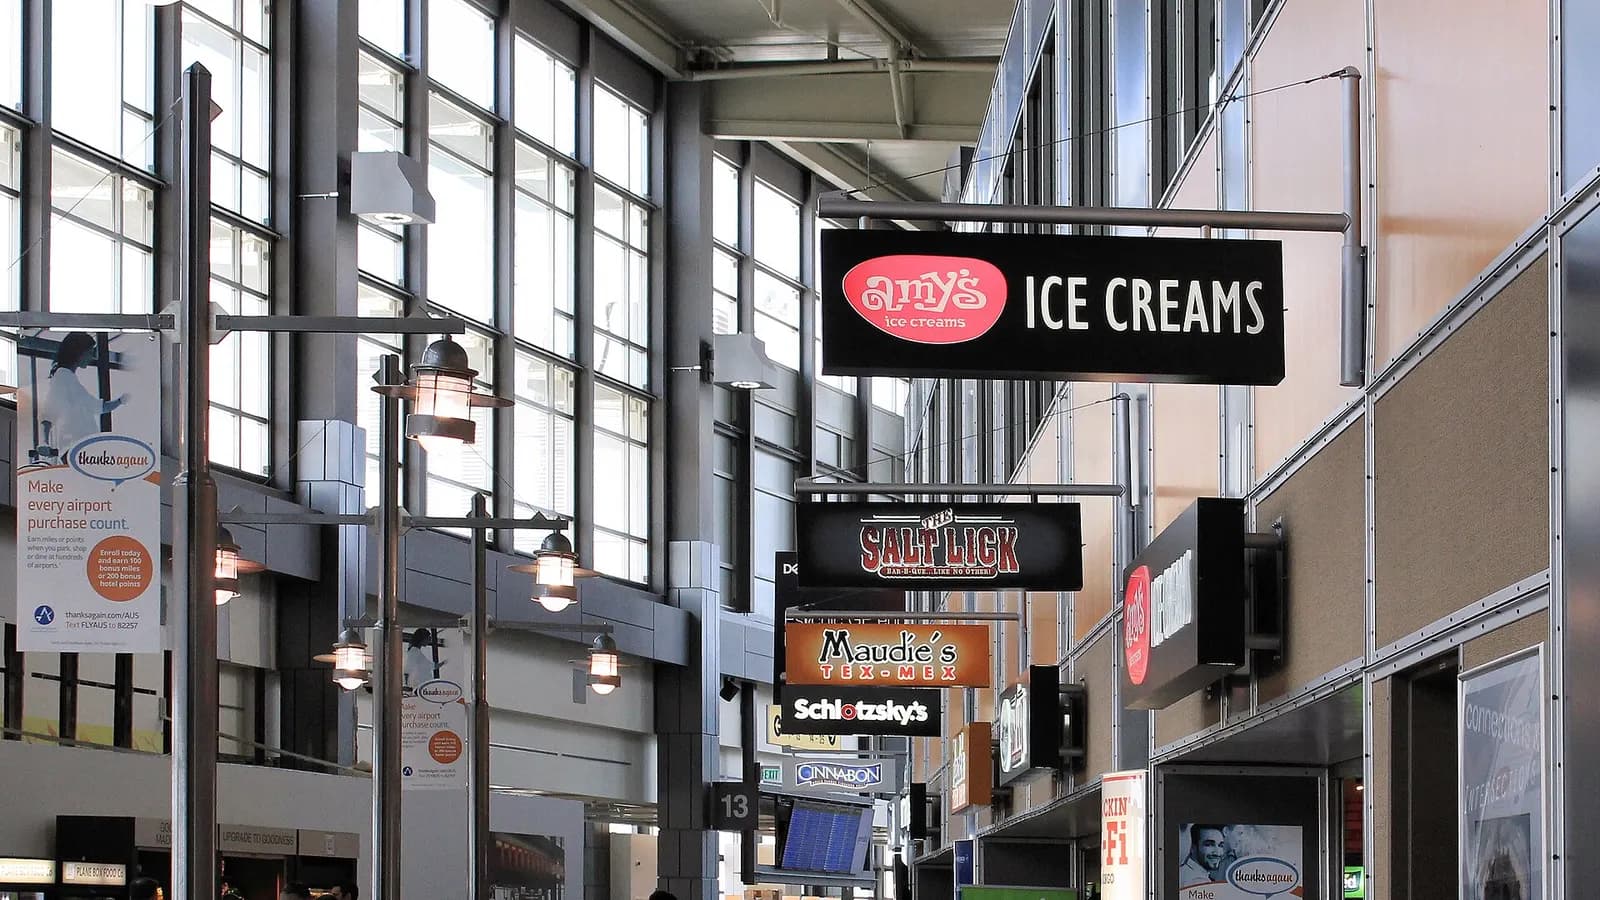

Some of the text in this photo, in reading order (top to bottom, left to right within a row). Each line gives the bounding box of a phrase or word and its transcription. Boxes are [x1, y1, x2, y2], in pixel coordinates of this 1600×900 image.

[861, 268, 987, 312] amy's
[1026, 275, 1265, 334] ICE CREAMS
[885, 315, 966, 328] ice creams
[28, 481, 63, 493] Make
[28, 499, 112, 515] every airport
[28, 517, 129, 532] purchase count.
[922, 508, 953, 529] THE
[73, 545, 87, 553] shop
[100, 549, 141, 558] Enroll today
[860, 526, 1019, 573] SALT LICK
[66, 611, 139, 620] thanksagain.com/AUS
[81, 621, 107, 629] FLYAUS
[117, 621, 138, 629] 82257
[819, 629, 957, 663] Maudie's
[820, 665, 956, 680] TEX-MEX
[418, 711, 440, 720] airport
[795, 699, 928, 725] Schlotzsky's
[402, 720, 429, 729] urchase
[764, 770, 779, 780] EXIT
[799, 764, 881, 783] CINNABON
[721, 794, 748, 818] 13
[76, 866, 92, 877] PLANE
[103, 868, 116, 878] FOOD
[1189, 889, 1215, 900] Make
